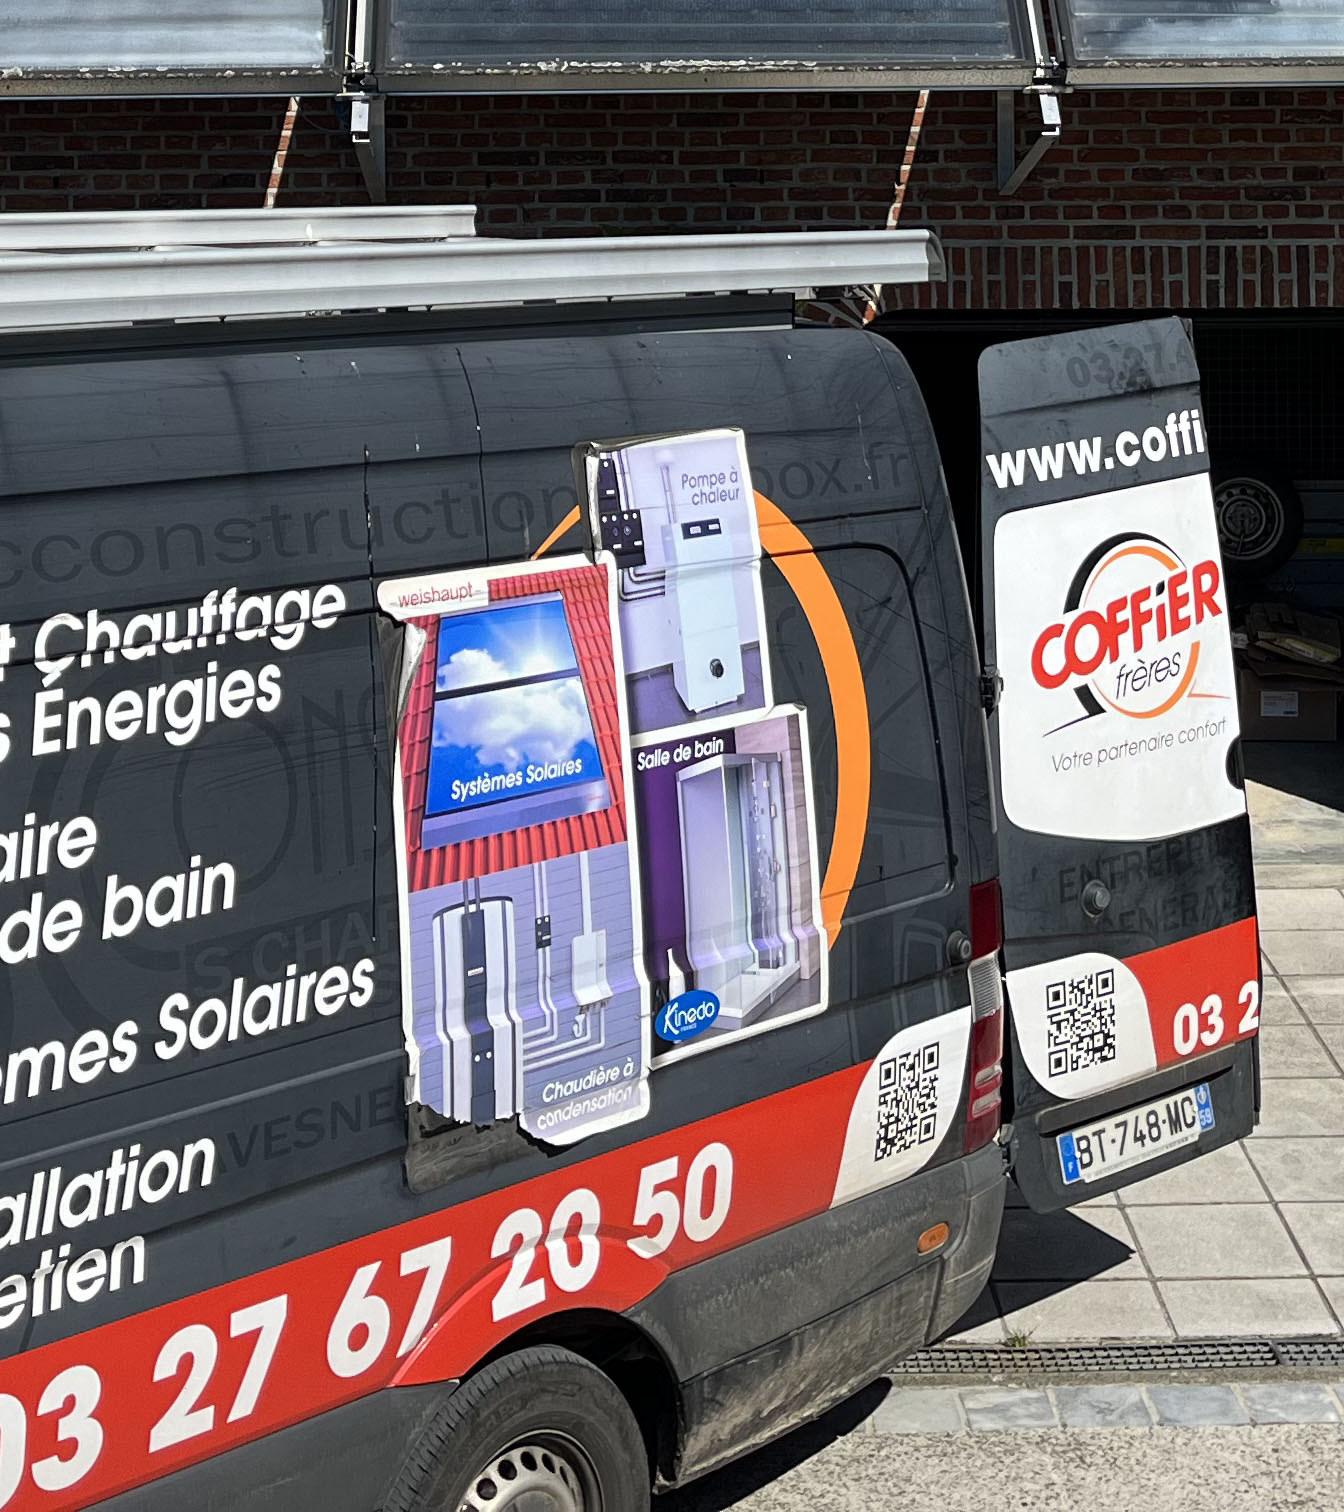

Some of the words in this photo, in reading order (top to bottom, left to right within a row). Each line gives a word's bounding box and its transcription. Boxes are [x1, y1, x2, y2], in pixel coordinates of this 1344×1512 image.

[985, 408, 1206, 489] www.coffi
[681, 472, 726, 491] Pompe
[729, 466, 739, 484] à
[691, 487, 740, 506] chaleur
[398, 581, 473, 608] weishaupt
[33, 584, 348, 671] Chauffage
[1031, 559, 1223, 689] COFFIER
[1116, 651, 1181, 700] frères
[31, 660, 283, 757] Énergies
[637, 747, 671, 771] Salle
[673, 743, 692, 762] de
[694, 736, 724, 759] bain
[1051, 751, 1093, 773] Votre
[1097, 732, 1174, 767] partenaire
[1177, 716, 1227, 745] confort
[450, 768, 523, 803] Systèmes
[526, 758, 583, 785] Solaires
[101, 854, 237, 941] bain
[154, 958, 376, 1061] Solaires
[663, 1000, 716, 1036] Kinedo
[1172, 993, 1226, 1057] 03
[542, 1065, 621, 1103] Chaudière
[622, 1056, 634, 1077] à
[537, 1085, 633, 1130] condensation
[1199, 1106, 1213, 1126] 59
[148, 1293, 289, 1454] 27
[326, 1235, 453, 1378] 67
[490, 1187, 602, 1323] 20
[627, 1142, 734, 1260] 50
